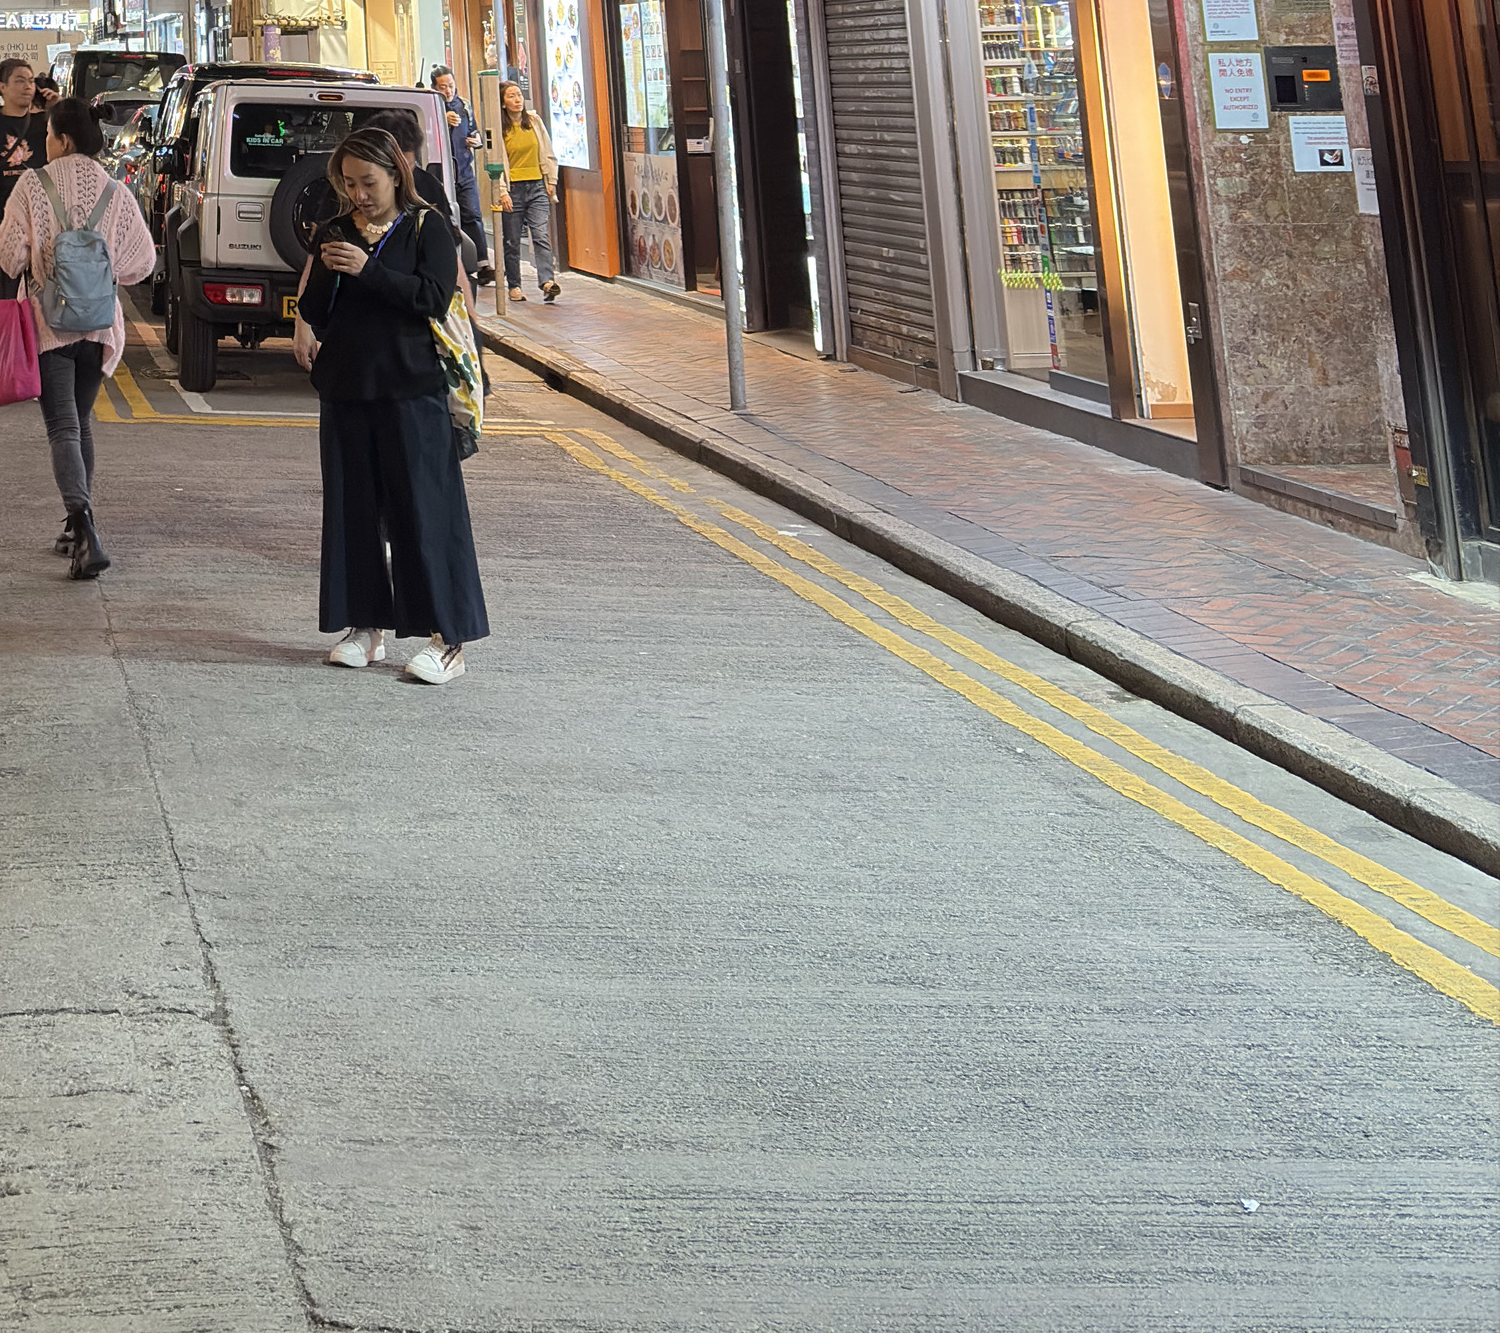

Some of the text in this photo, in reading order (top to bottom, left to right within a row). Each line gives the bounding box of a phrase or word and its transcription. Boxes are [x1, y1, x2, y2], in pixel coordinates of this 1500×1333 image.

[19, 13, 81, 30] 東亞銀行
[6, 42, 25, 52] (HK)
[25, 43, 39, 51] Ltd
[1217, 58, 1252, 68] 私人地方
[228, 243, 262, 251] SUZUKI
